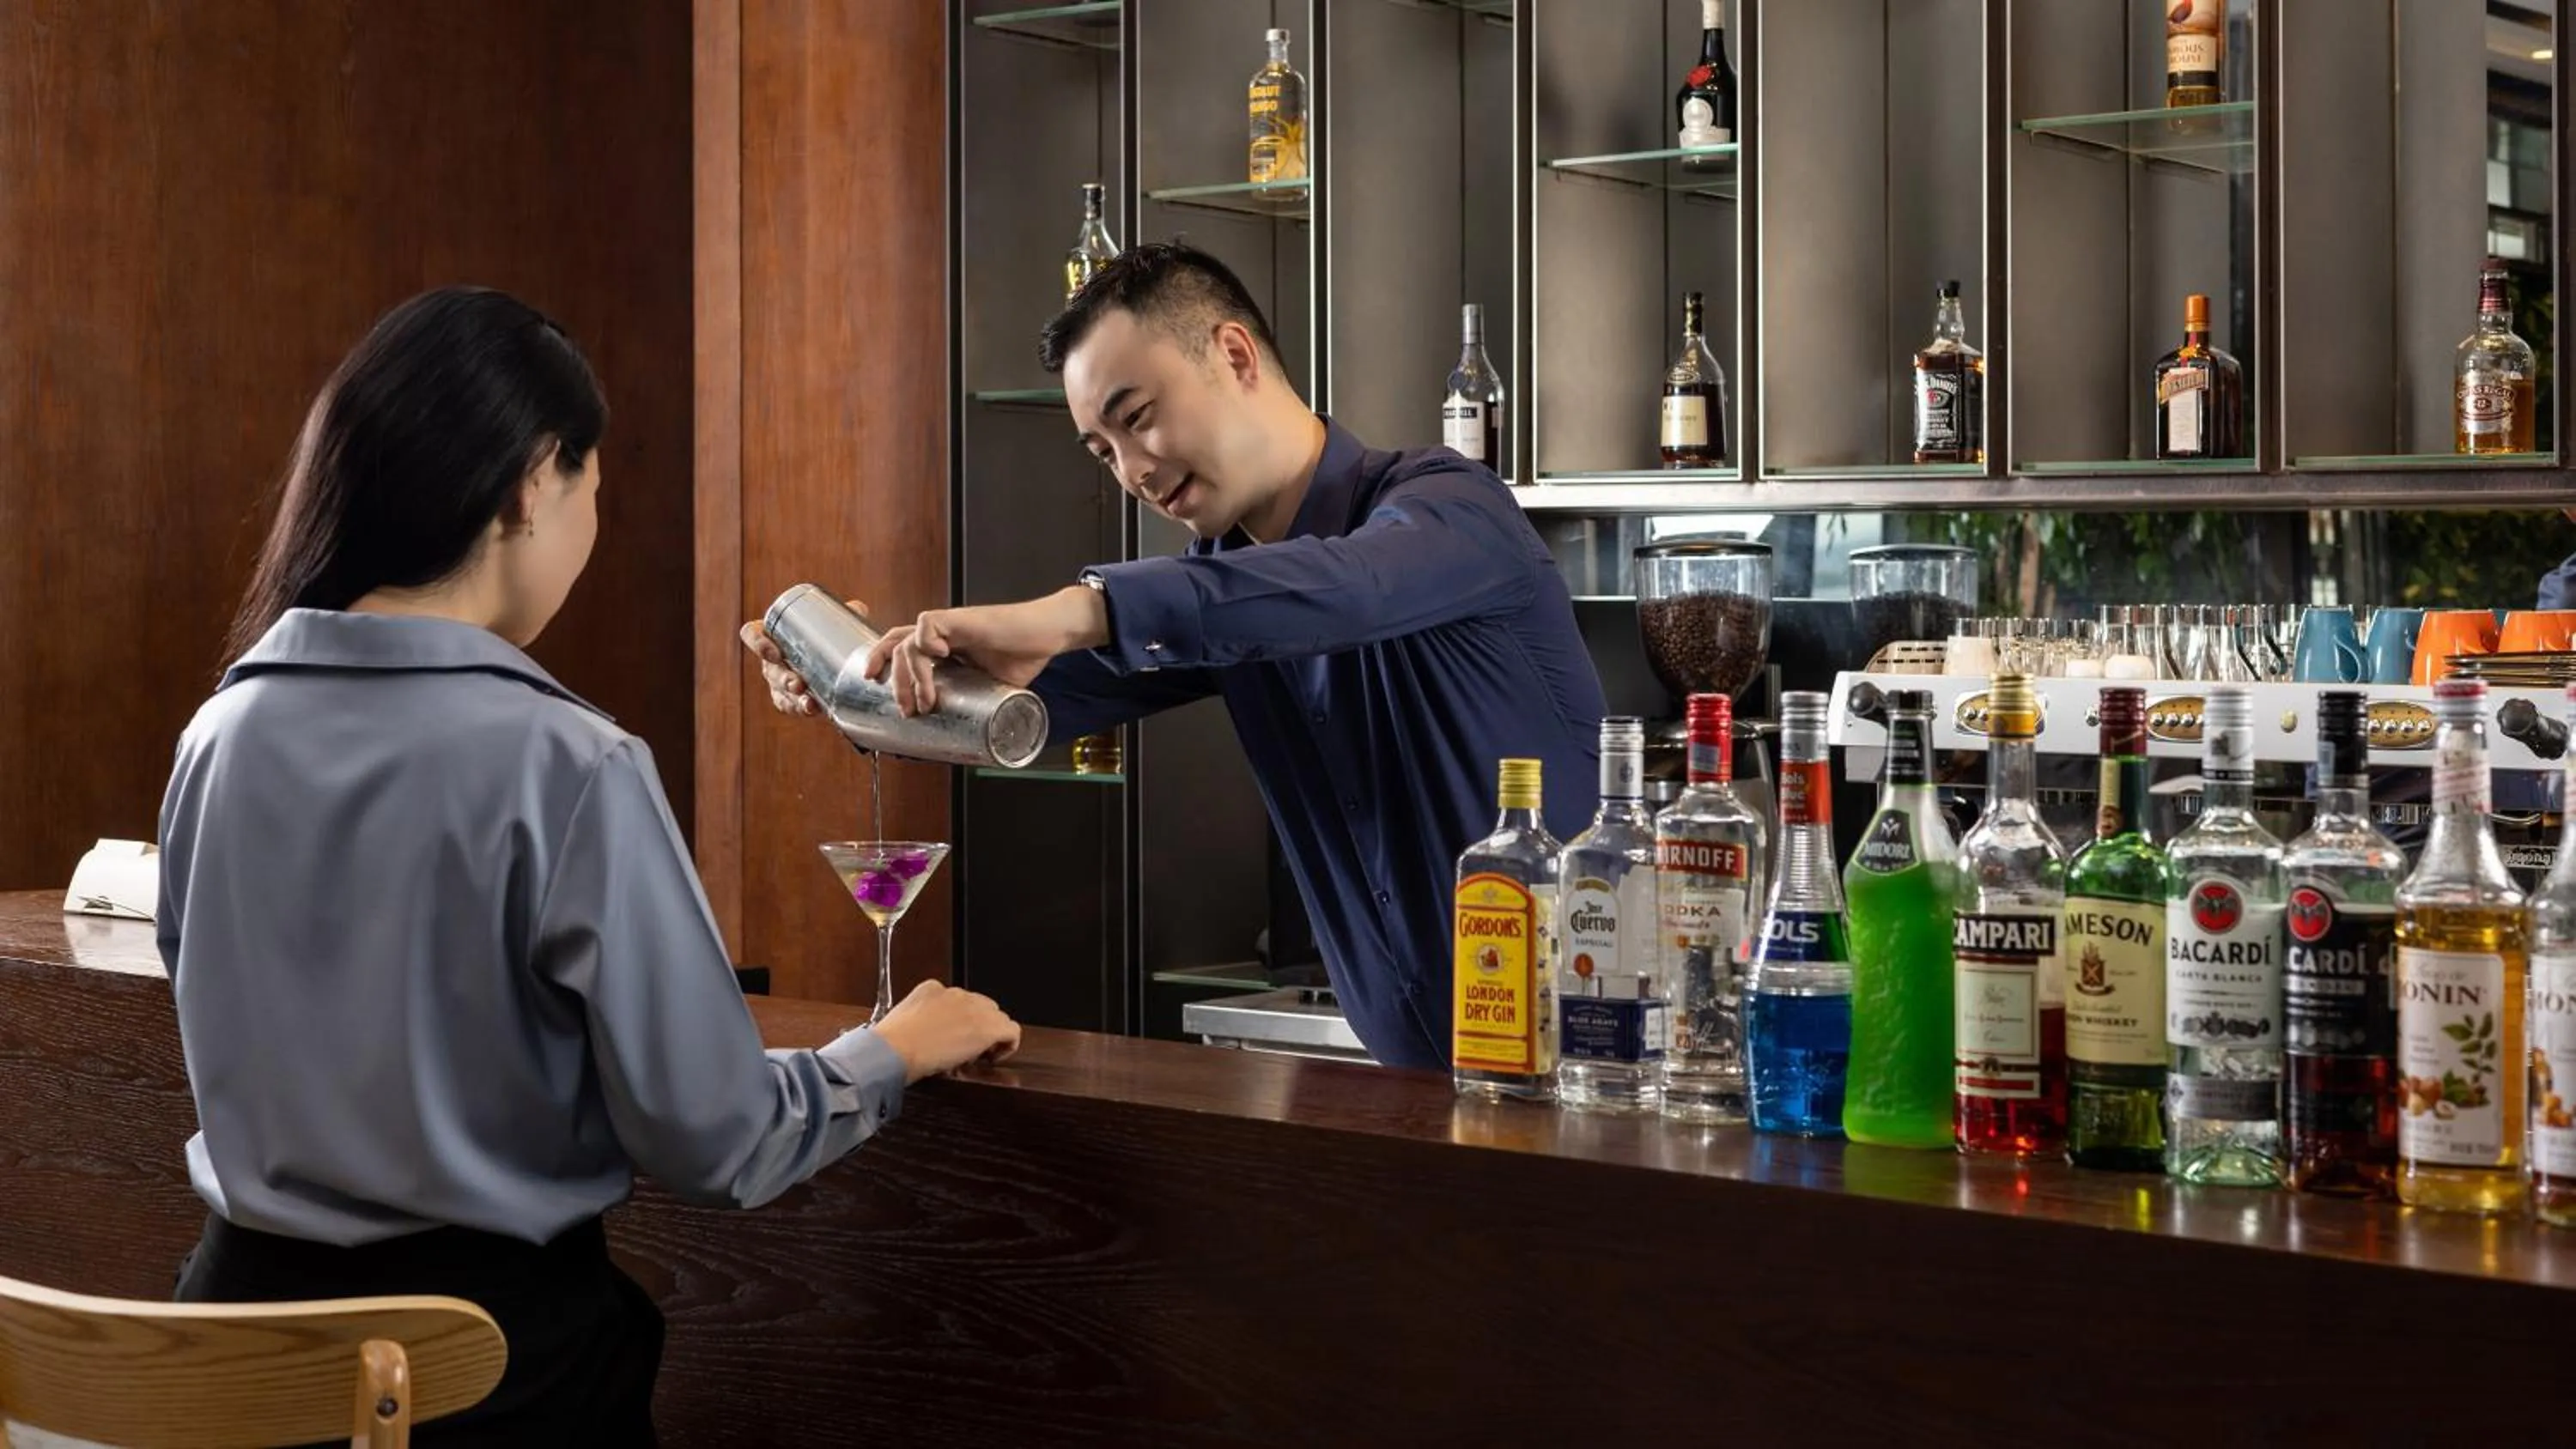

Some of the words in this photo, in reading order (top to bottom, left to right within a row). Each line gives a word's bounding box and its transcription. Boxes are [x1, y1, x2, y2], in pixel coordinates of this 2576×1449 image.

[1657, 845, 1735, 870] IRNOFF
[1571, 909, 1616, 934] Cuervo
[1664, 904, 1722, 917] ODKA
[1460, 911, 1522, 937] GORDON'S
[2065, 912, 2154, 947] AMESON
[2171, 934, 2272, 965] BACARDÍ
[2287, 943, 2367, 975] CARDÍ
[1466, 985, 1516, 1003] LONDON
[2404, 982, 2481, 1006] ONIN
[1465, 1002, 1491, 1022] DRY
[1492, 1004, 1516, 1024] GIN
